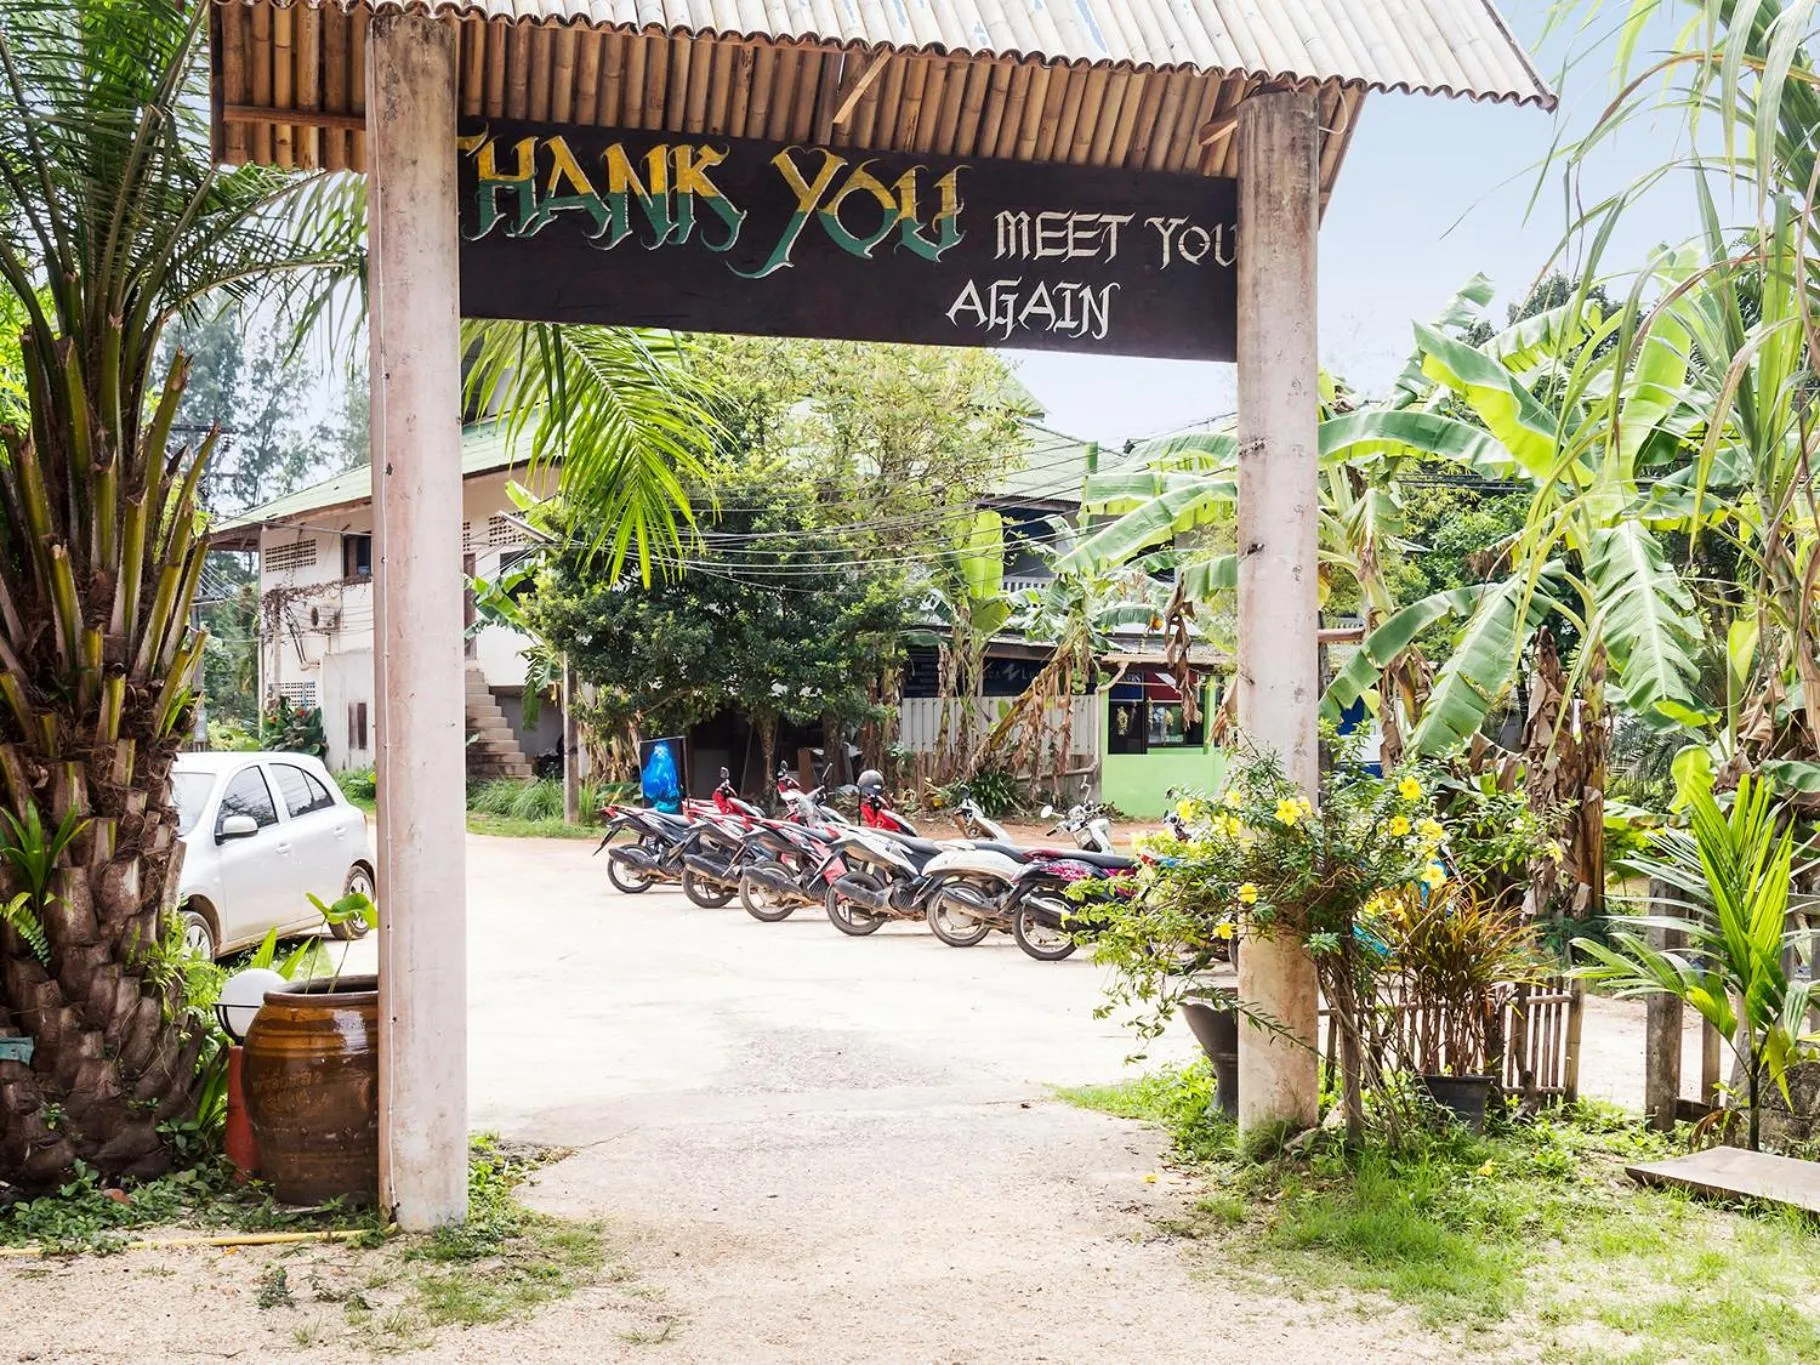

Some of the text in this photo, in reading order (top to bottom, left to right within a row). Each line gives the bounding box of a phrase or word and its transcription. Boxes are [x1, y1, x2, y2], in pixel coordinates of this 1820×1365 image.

[726, 145, 972, 280] YOU
[993, 208, 1136, 265] MEET
[945, 275, 1121, 341] AGAIN
